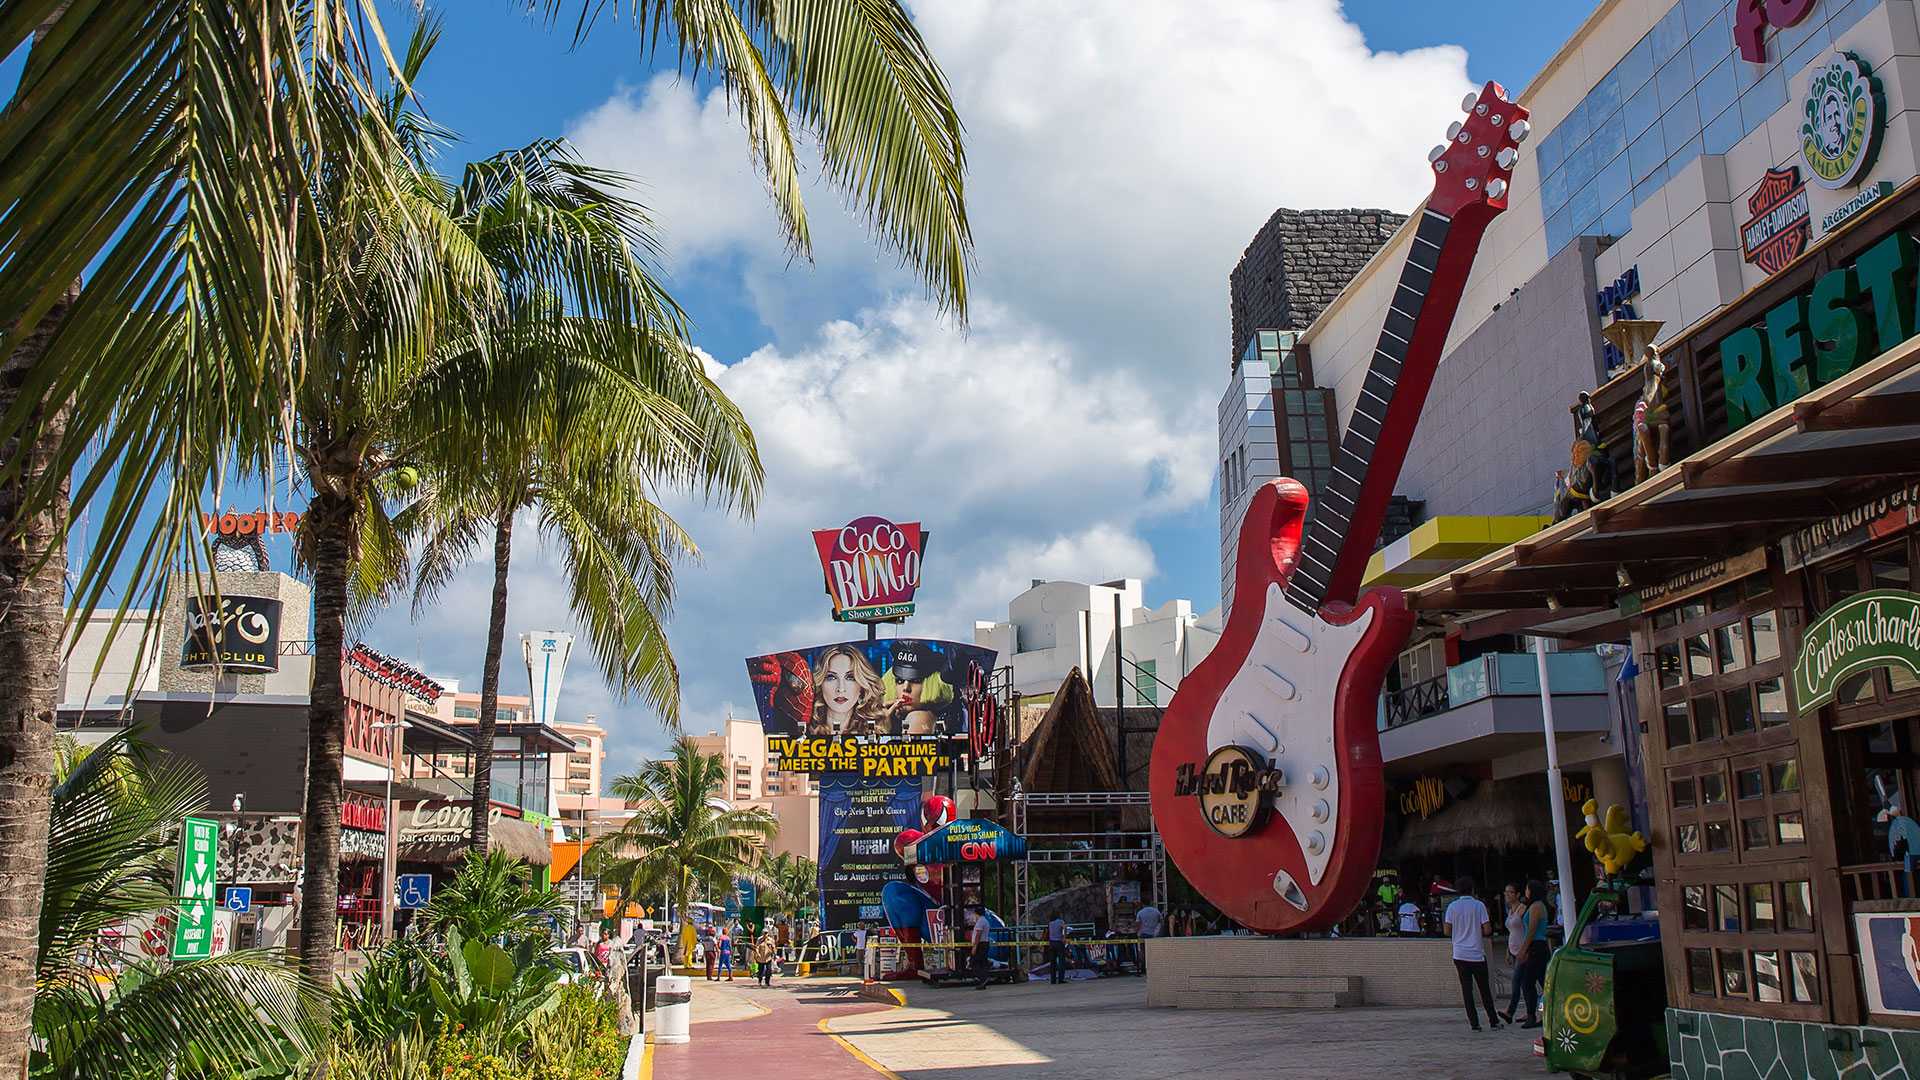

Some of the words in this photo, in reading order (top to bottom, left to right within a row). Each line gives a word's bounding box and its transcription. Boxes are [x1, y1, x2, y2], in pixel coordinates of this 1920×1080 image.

[1755, 181, 1790, 213] MOTOR
[1822, 183, 1881, 232] ARGENTINIAN
[1745, 191, 1809, 251] HARLEY-DAVIDSON
[1597, 264, 1641, 316] PLAZA
[1720, 232, 1920, 431] REST
[830, 550, 920, 609] BONGO
[848, 610, 872, 619] Show
[874, 608, 882, 616] &
[885, 605, 910, 614] Disco
[222, 652, 265, 663] CLUB
[897, 651, 918, 663] GAGA
[769, 739, 857, 758] "VEGAS
[860, 743, 937, 757] SHOWTIME
[779, 758, 826, 771] MEETS
[830, 757, 857, 770] THE
[864, 756, 949, 777] PARTY"
[1174, 763, 1229, 797] Hard
[1229, 758, 1283, 801] Rock
[834, 807, 848, 817] The
[848, 807, 865, 817] New
[866, 806, 884, 817] York
[886, 806, 906, 815] Times
[1211, 804, 1248, 825] CAFE
[400, 833, 417, 843] bar
[423, 833, 460, 843] cancun
[949, 825, 965, 834] PUTS
[971, 832, 978, 840] TO
[851, 839, 890, 855] Herald
[961, 842, 997, 861] CNN
[834, 872, 848, 881] Los
[849, 872, 879, 882] Angeles
[883, 871, 907, 880] Times
